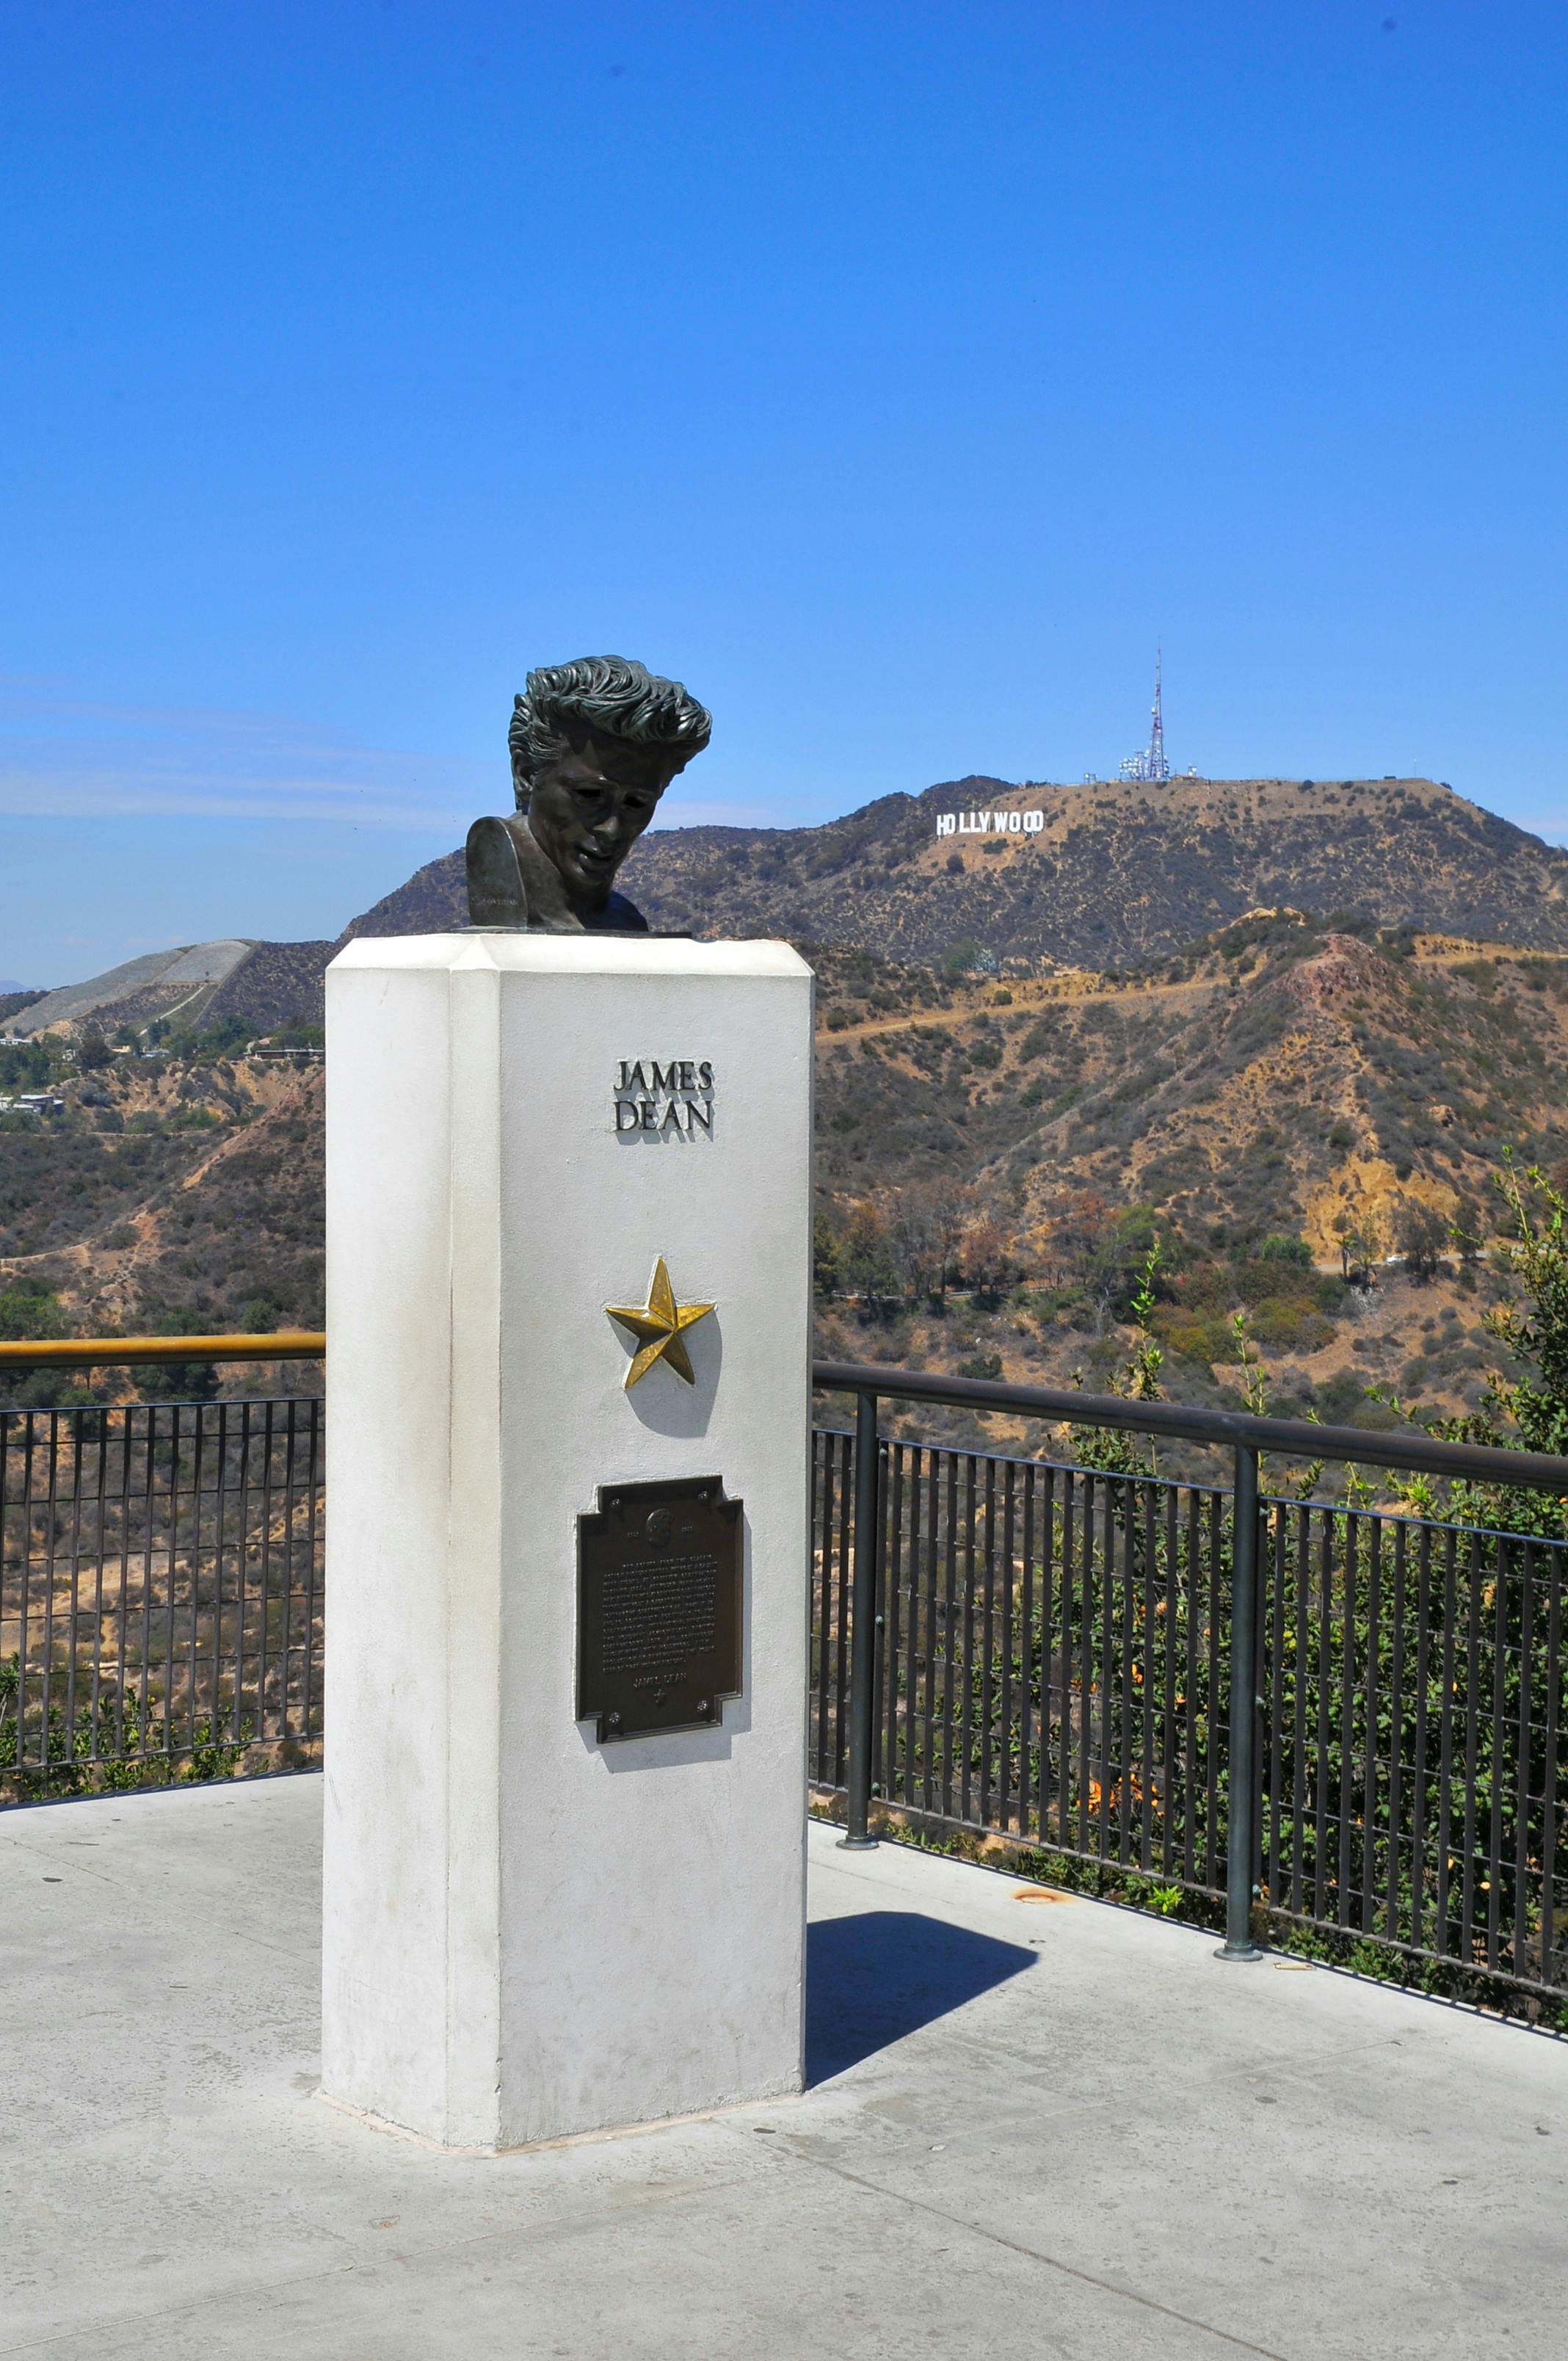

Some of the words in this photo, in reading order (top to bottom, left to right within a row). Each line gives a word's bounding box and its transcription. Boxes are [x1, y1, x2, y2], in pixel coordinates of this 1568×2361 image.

[936, 810, 1044, 835] HOLLYWOOD
[613, 1060, 712, 1091] JAMES
[613, 1100, 712, 1131] DEAN
